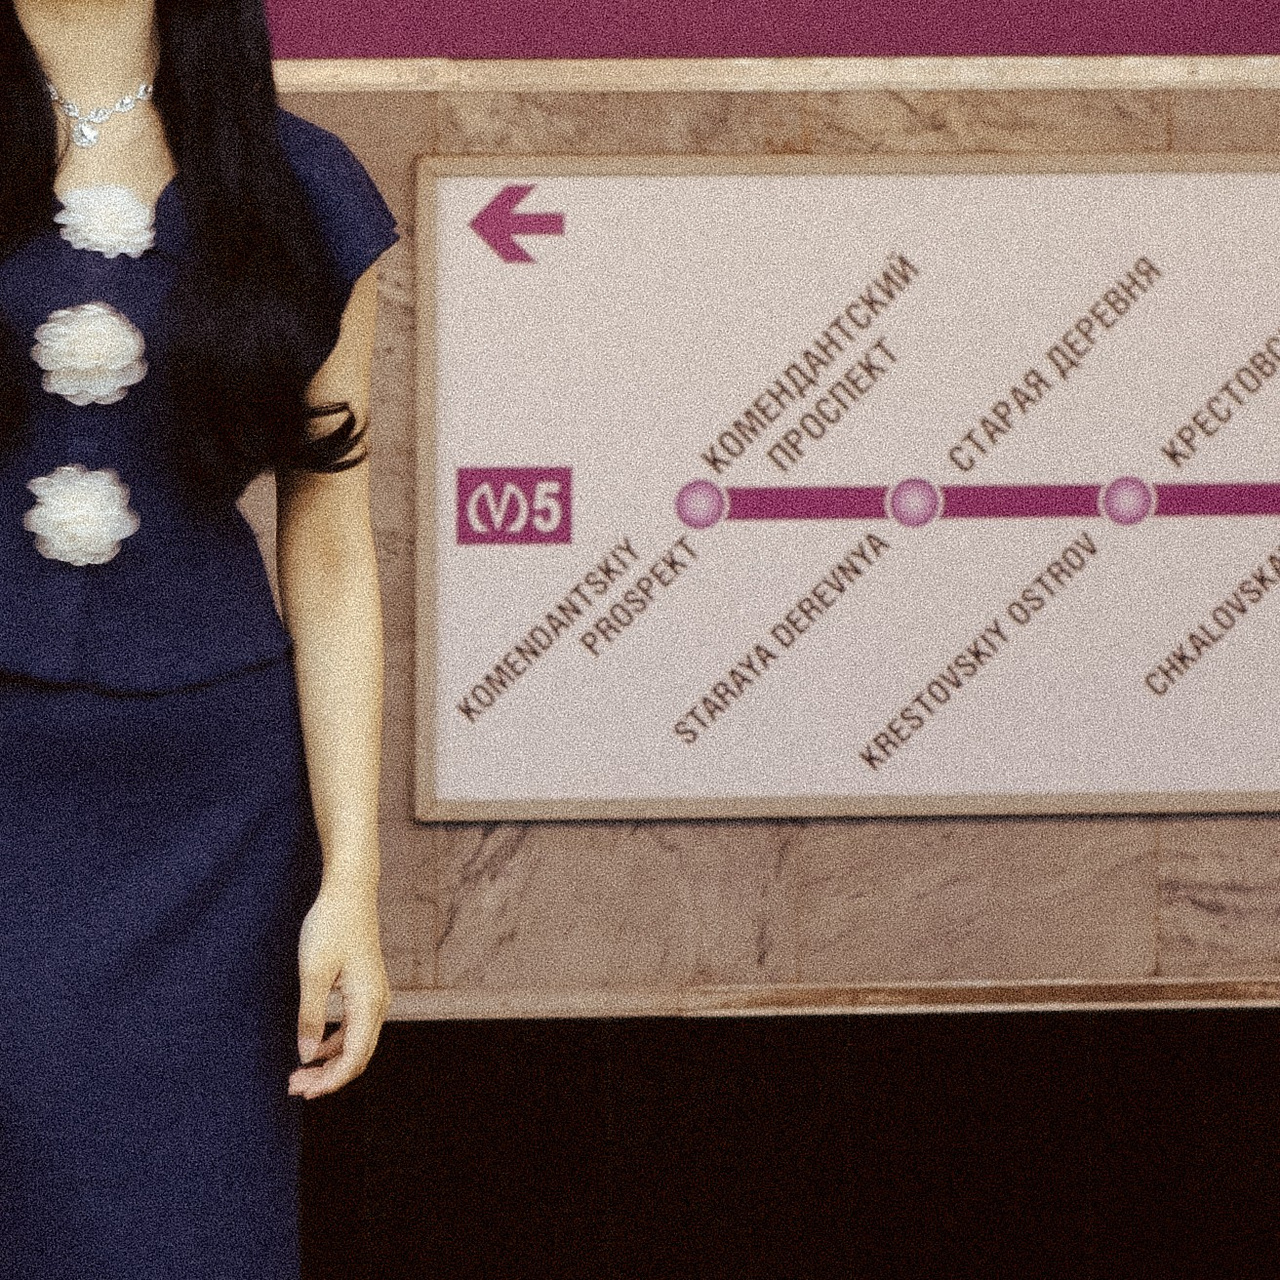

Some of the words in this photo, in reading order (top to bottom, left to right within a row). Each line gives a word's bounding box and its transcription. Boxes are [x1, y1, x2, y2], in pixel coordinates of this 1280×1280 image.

[701, 251, 921, 474] КОМЕНДАНТСКИЙ
[767, 336, 898, 472] ПРОСПЕКТ
[948, 368, 1052, 472] СТАРАЯ
[1046, 256, 1163, 380] ДЕРЕВНЯ
[457, 536, 640, 724] KOMENDANTSKIY
[580, 535, 699, 658] PROSPEKT
[673, 643, 779, 745] STARAYA
[770, 532, 891, 649] DEREVNYA
[859, 619, 1009, 771] KRESTOVSKIY
[1006, 531, 1098, 627] OSTROV
